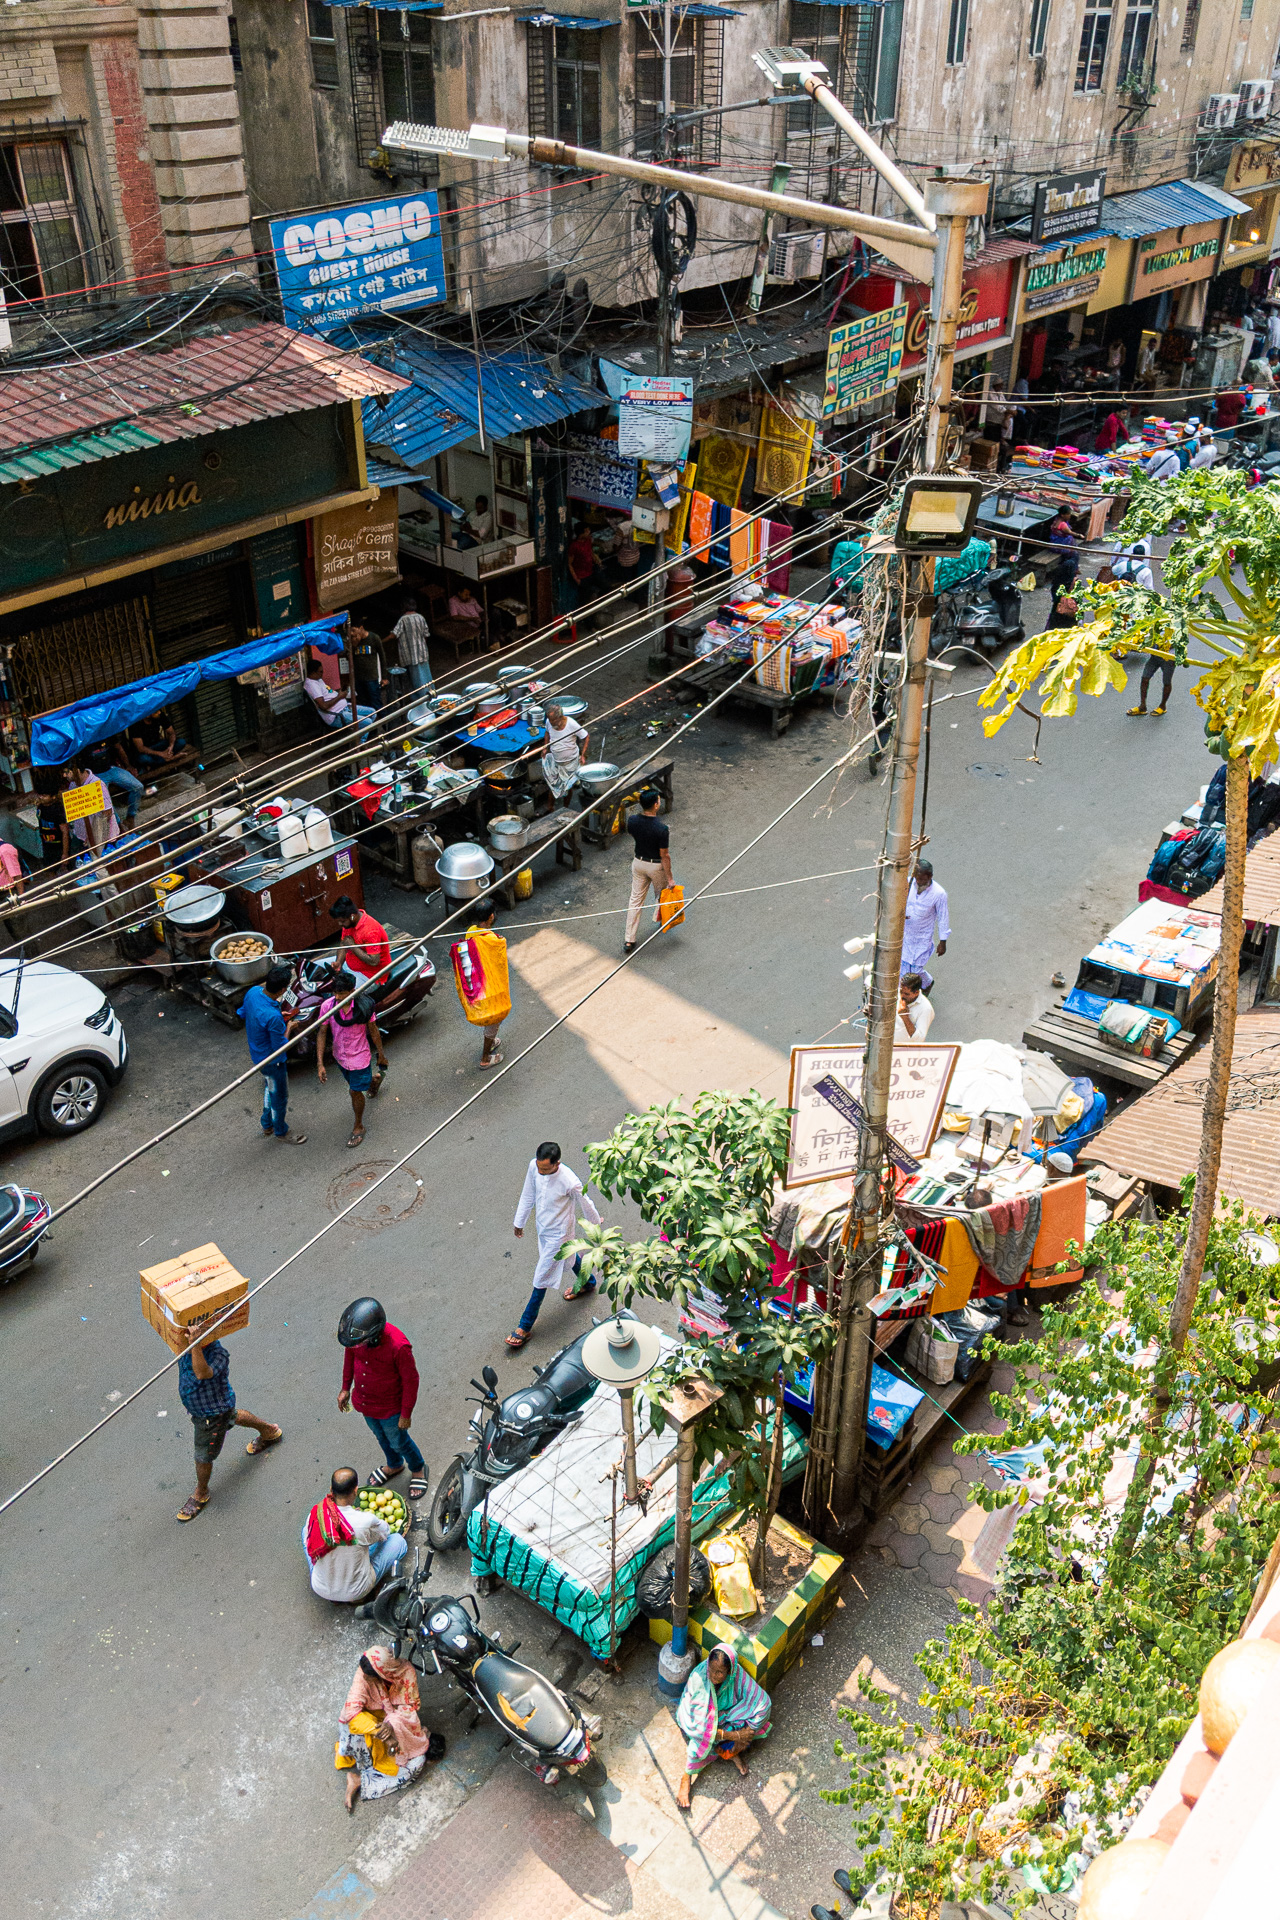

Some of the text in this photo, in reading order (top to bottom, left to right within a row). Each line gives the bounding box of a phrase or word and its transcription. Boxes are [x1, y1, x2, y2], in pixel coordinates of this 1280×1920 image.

[283, 201, 431, 266] COSMO
[309, 248, 410, 286] GUEST HOUSE
[840, 345, 868, 368] SUPER
[869, 336, 890, 356] STAR
[860, 351, 888, 370] JEWELLERS
[321, 528, 394, 556] Shaqib Gems
